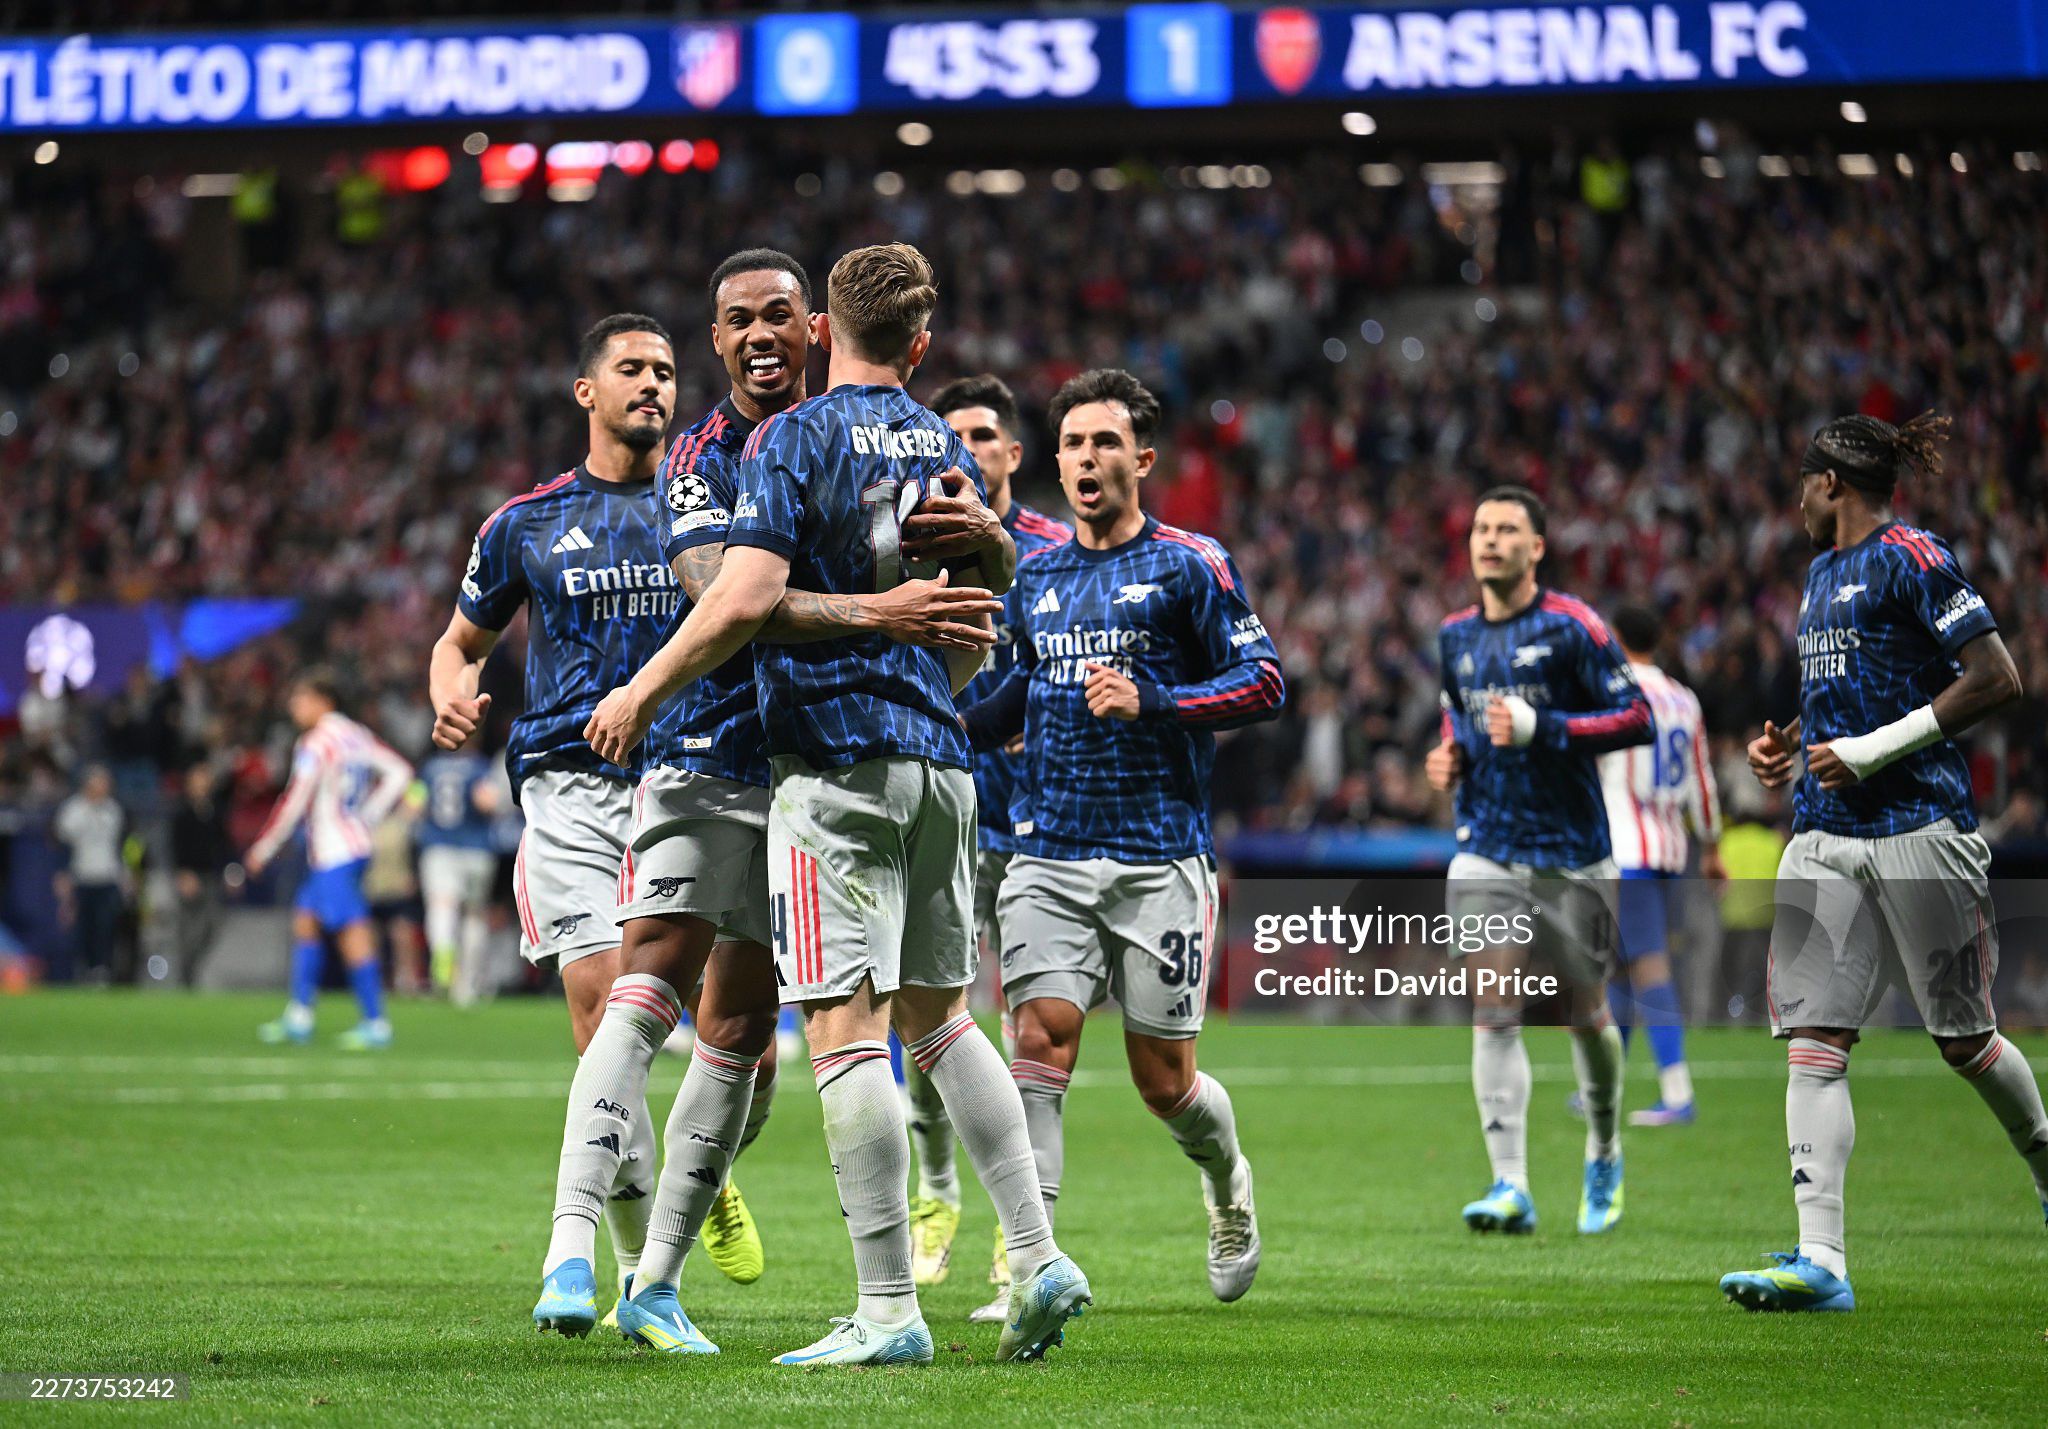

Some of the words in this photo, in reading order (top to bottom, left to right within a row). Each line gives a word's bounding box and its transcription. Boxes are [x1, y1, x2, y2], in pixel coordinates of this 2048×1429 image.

[776, 27, 835, 104] 0
[1159, 20, 1198, 97] 1
[1345, 4, 1699, 89] ARSENAL
[1710, 1, 1808, 78] FC
[257, 42, 354, 119] DE
[360, 33, 650, 116] MADRID
[593, 595, 621, 621] FLY
[1035, 624, 1151, 660] Emirates
[1159, 930, 1203, 988] 36
[1927, 944, 1981, 999] 20
[593, 1098, 629, 1121] AFC
